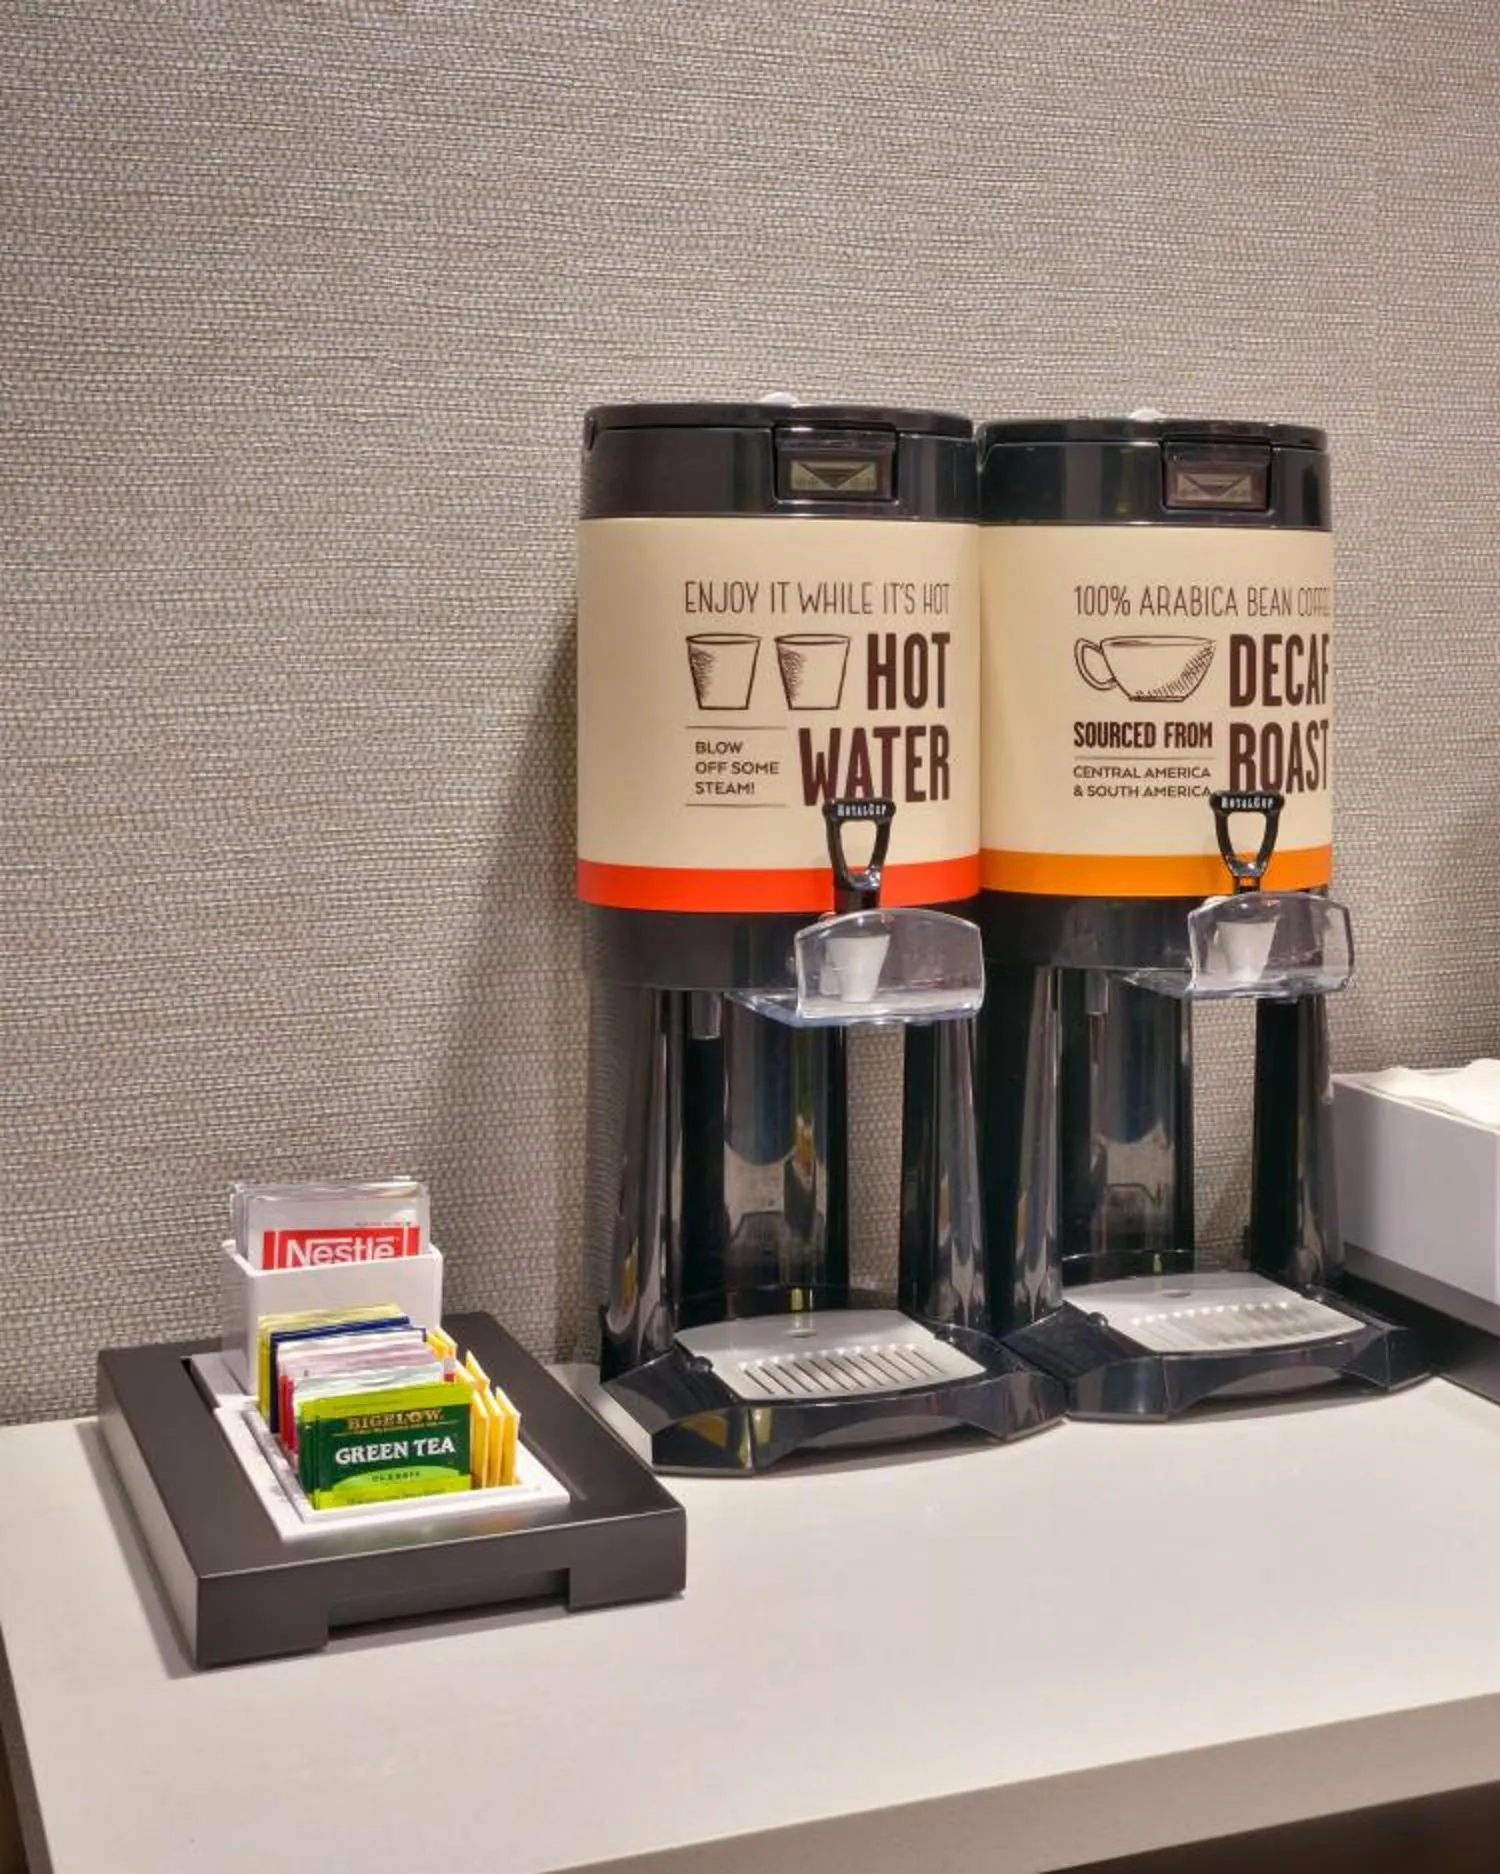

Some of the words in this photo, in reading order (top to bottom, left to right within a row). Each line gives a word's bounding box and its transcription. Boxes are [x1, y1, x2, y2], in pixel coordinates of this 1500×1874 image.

[685, 580, 760, 615] ENJOY
[771, 581, 791, 615] IT
[797, 581, 873, 615] WHILE
[883, 581, 916, 615] IT'S
[923, 582, 951, 615] HOT
[1073, 584, 1131, 617] 100%
[1139, 584, 1239, 617] ARABICA
[1247, 586, 1292, 617] BEAN
[867, 631, 951, 711] HOT
[1229, 632, 1330, 708] DECAF
[694, 740, 744, 755] BLOW
[1073, 720, 1157, 749] SOURCED
[1164, 720, 1213, 749] FROM
[694, 761, 728, 775] OFF
[731, 761, 780, 775] SOME
[798, 724, 950, 807] WATER
[1229, 719, 1330, 794] ROAST
[1073, 765, 1141, 779] CENTRAL
[1144, 765, 1212, 779] AMERICA
[694, 781, 755, 796] STEAM!
[1073, 785, 1083, 798] &
[1087, 784, 1140, 798] SOUTH
[1141, 784, 1212, 798] AMERICA
[348, 1408, 443, 1430] BIGELOW
[335, 1440, 409, 1465] GREEN
[413, 1436, 457, 1458] TEA
